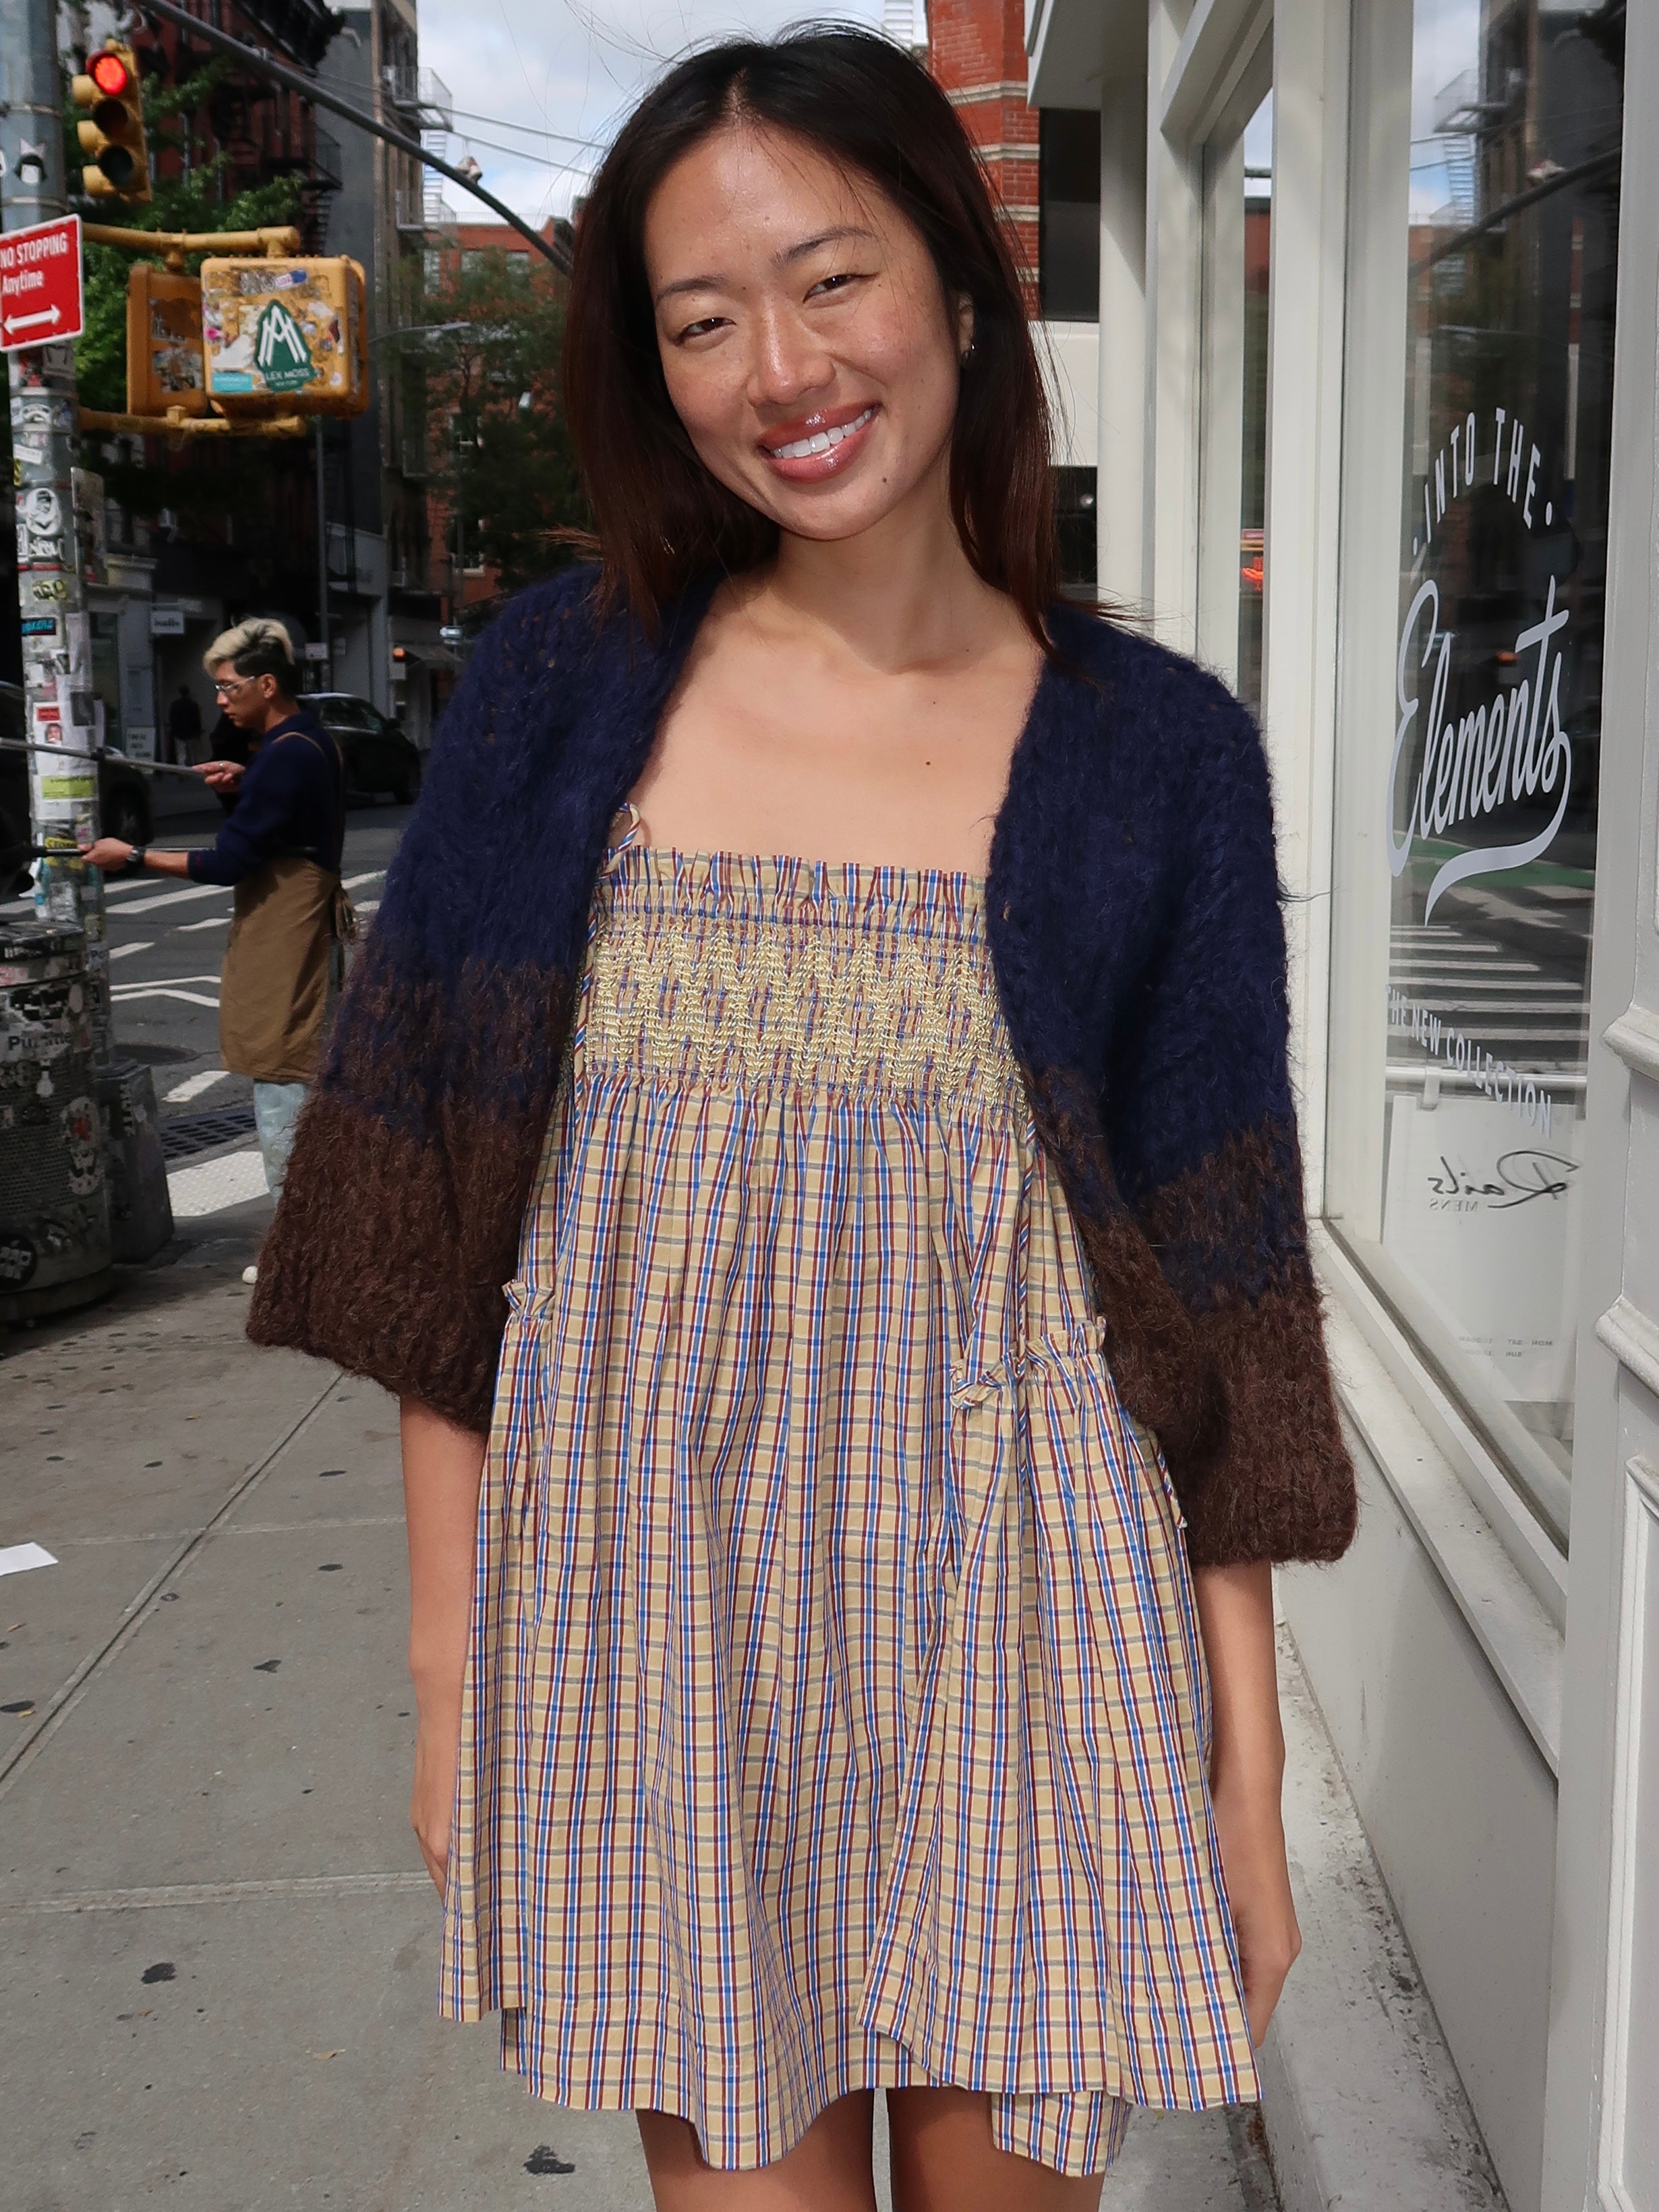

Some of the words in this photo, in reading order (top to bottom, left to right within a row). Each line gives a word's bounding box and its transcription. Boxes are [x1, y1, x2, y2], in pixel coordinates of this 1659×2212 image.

[1, 248, 15, 268] NO
[17, 232, 67, 265] STOPPING
[3, 270, 44, 295] Anytime
[1424, 411, 1476, 544] INTO
[1494, 407, 1541, 529] THE
[1387, 575, 1571, 927] Elements
[1411, 1004, 1441, 1055] NEW
[1447, 1028, 1551, 1140] COLLECTION
